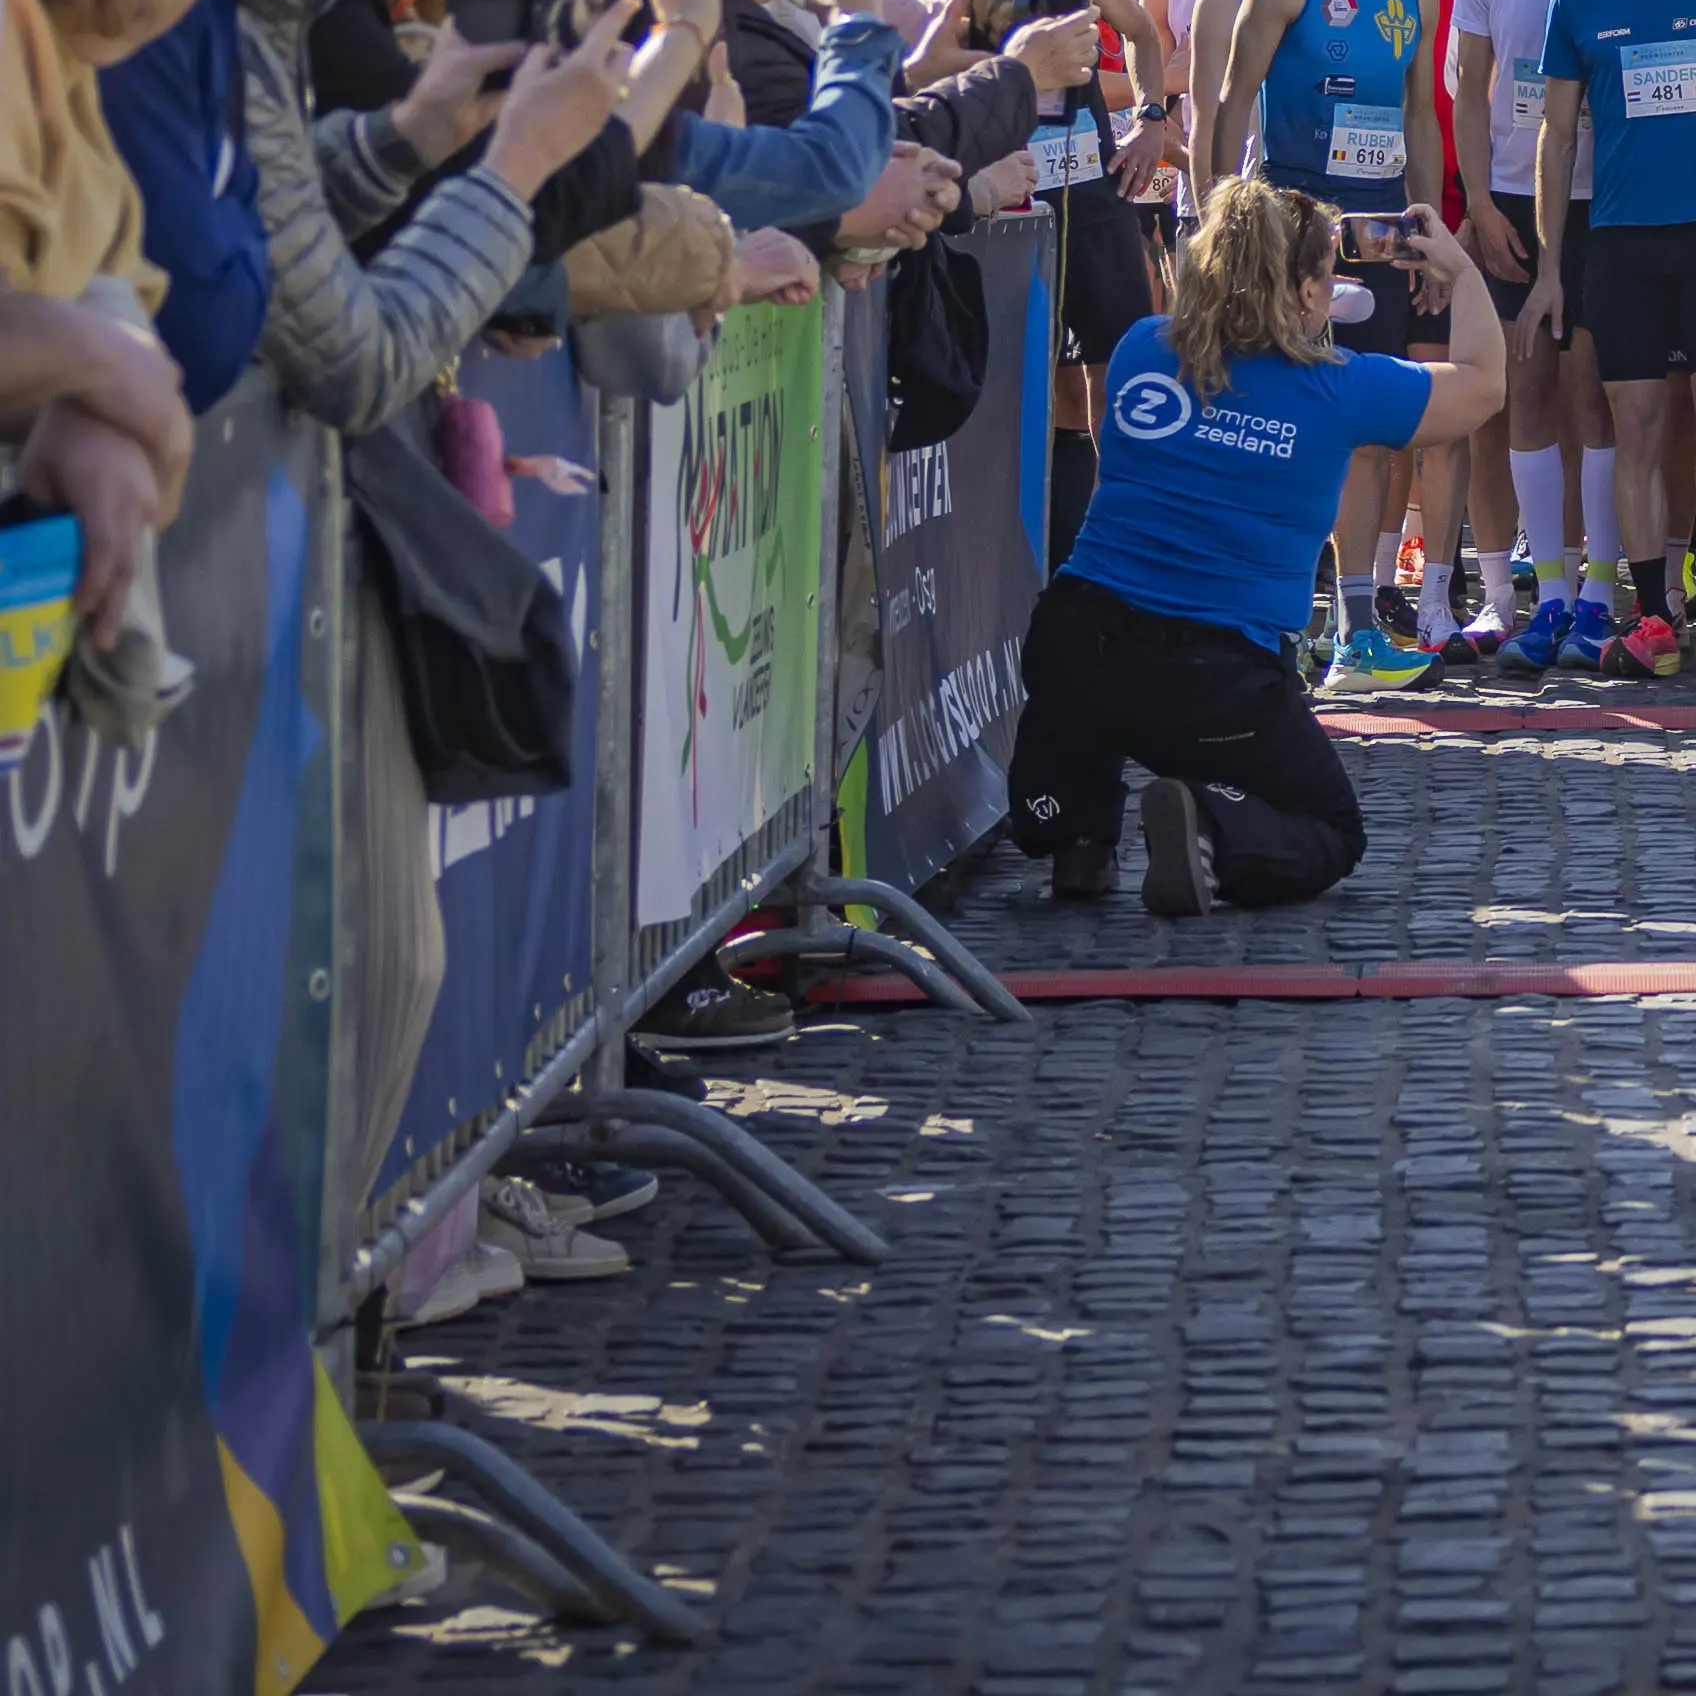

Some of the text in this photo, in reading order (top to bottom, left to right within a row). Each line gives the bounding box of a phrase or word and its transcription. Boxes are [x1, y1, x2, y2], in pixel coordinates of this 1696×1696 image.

[1651, 83, 1684, 102] 481
[1042, 140, 1078, 157] WIM
[1347, 132, 1395, 149] RUBEN
[1046, 155, 1079, 175] 745
[1356, 148, 1386, 166] 619
[1201, 405, 1297, 441] omroep
[1193, 423, 1296, 459] zeeland
